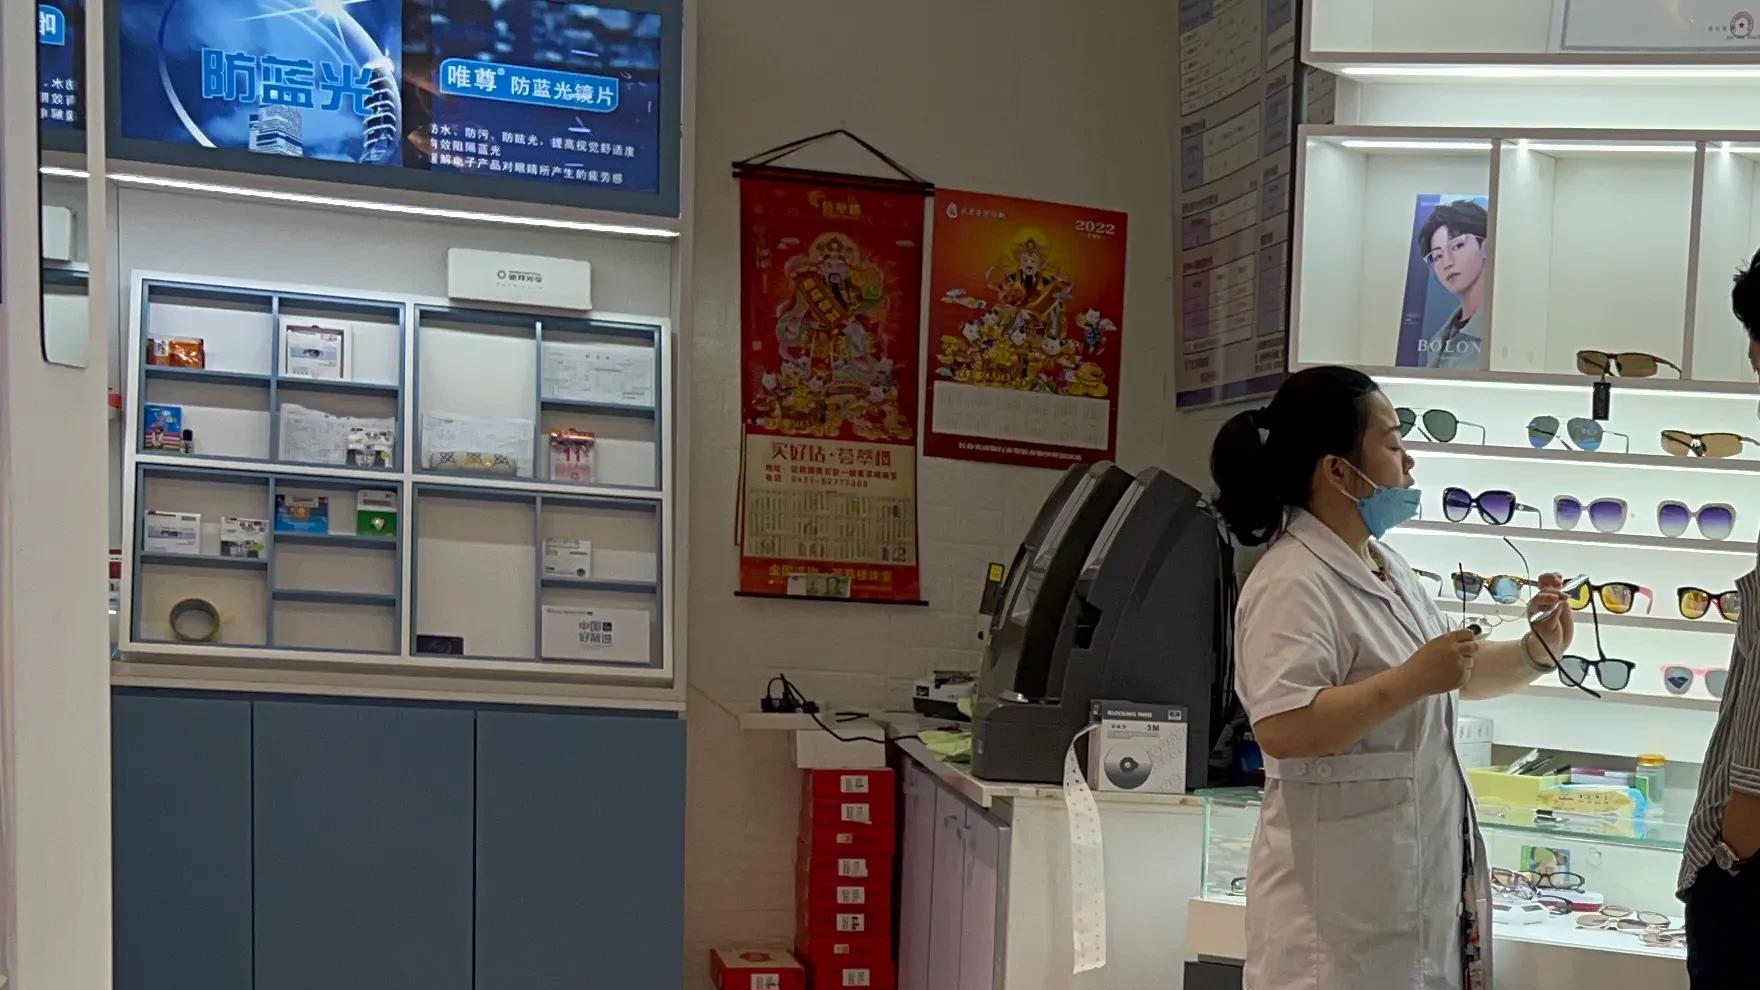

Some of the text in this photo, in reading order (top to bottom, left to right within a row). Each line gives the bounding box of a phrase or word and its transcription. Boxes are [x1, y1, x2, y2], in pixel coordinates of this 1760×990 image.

[202, 47, 374, 117] 防蓝光
[447, 65, 615, 107] 唯尊 防蓝光镜片
[1075, 220, 1116, 235] 2022
[1417, 338, 1481, 353] BOLON
